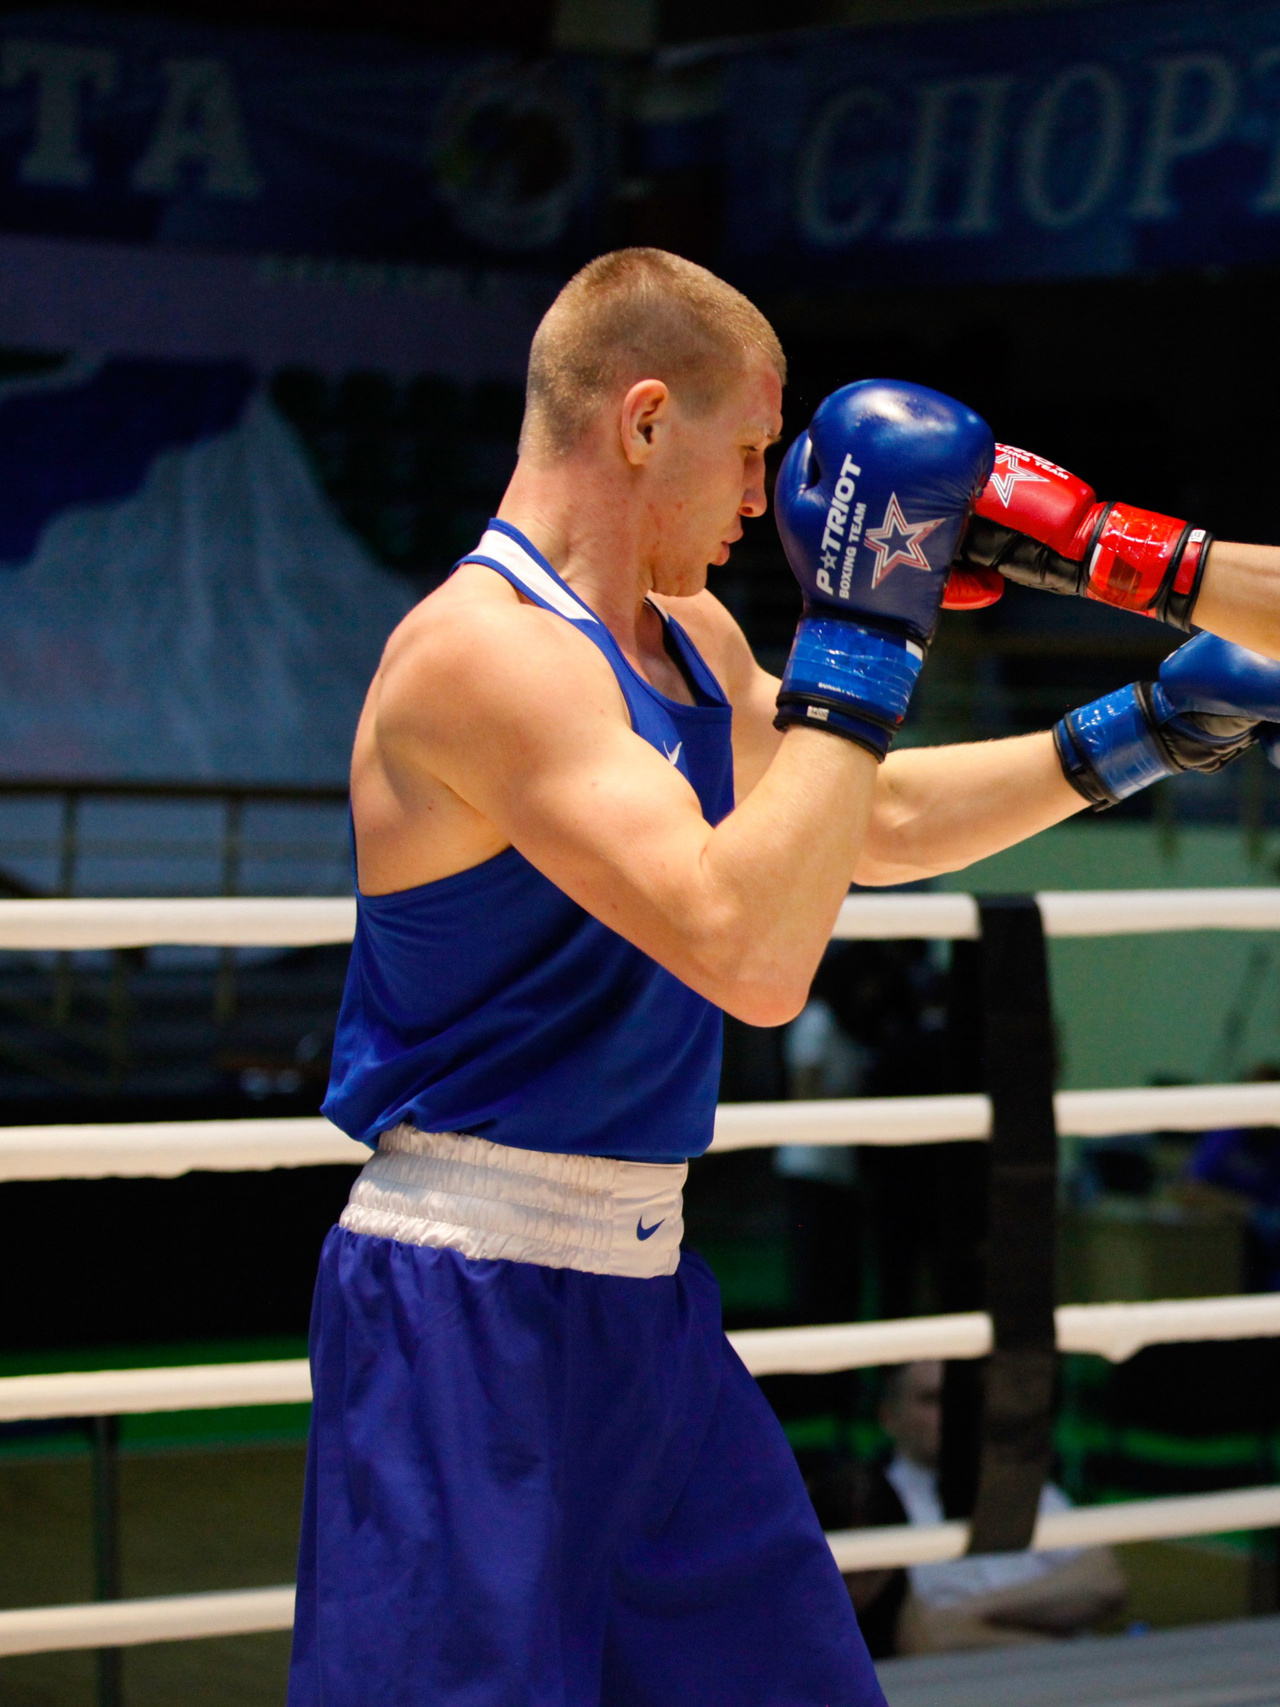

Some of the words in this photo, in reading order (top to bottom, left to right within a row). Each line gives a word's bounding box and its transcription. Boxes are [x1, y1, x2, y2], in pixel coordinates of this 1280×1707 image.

[1034, 459, 1069, 480] TEAM
[848, 502, 867, 543] TEAM
[839, 545, 858, 600] BOXING
